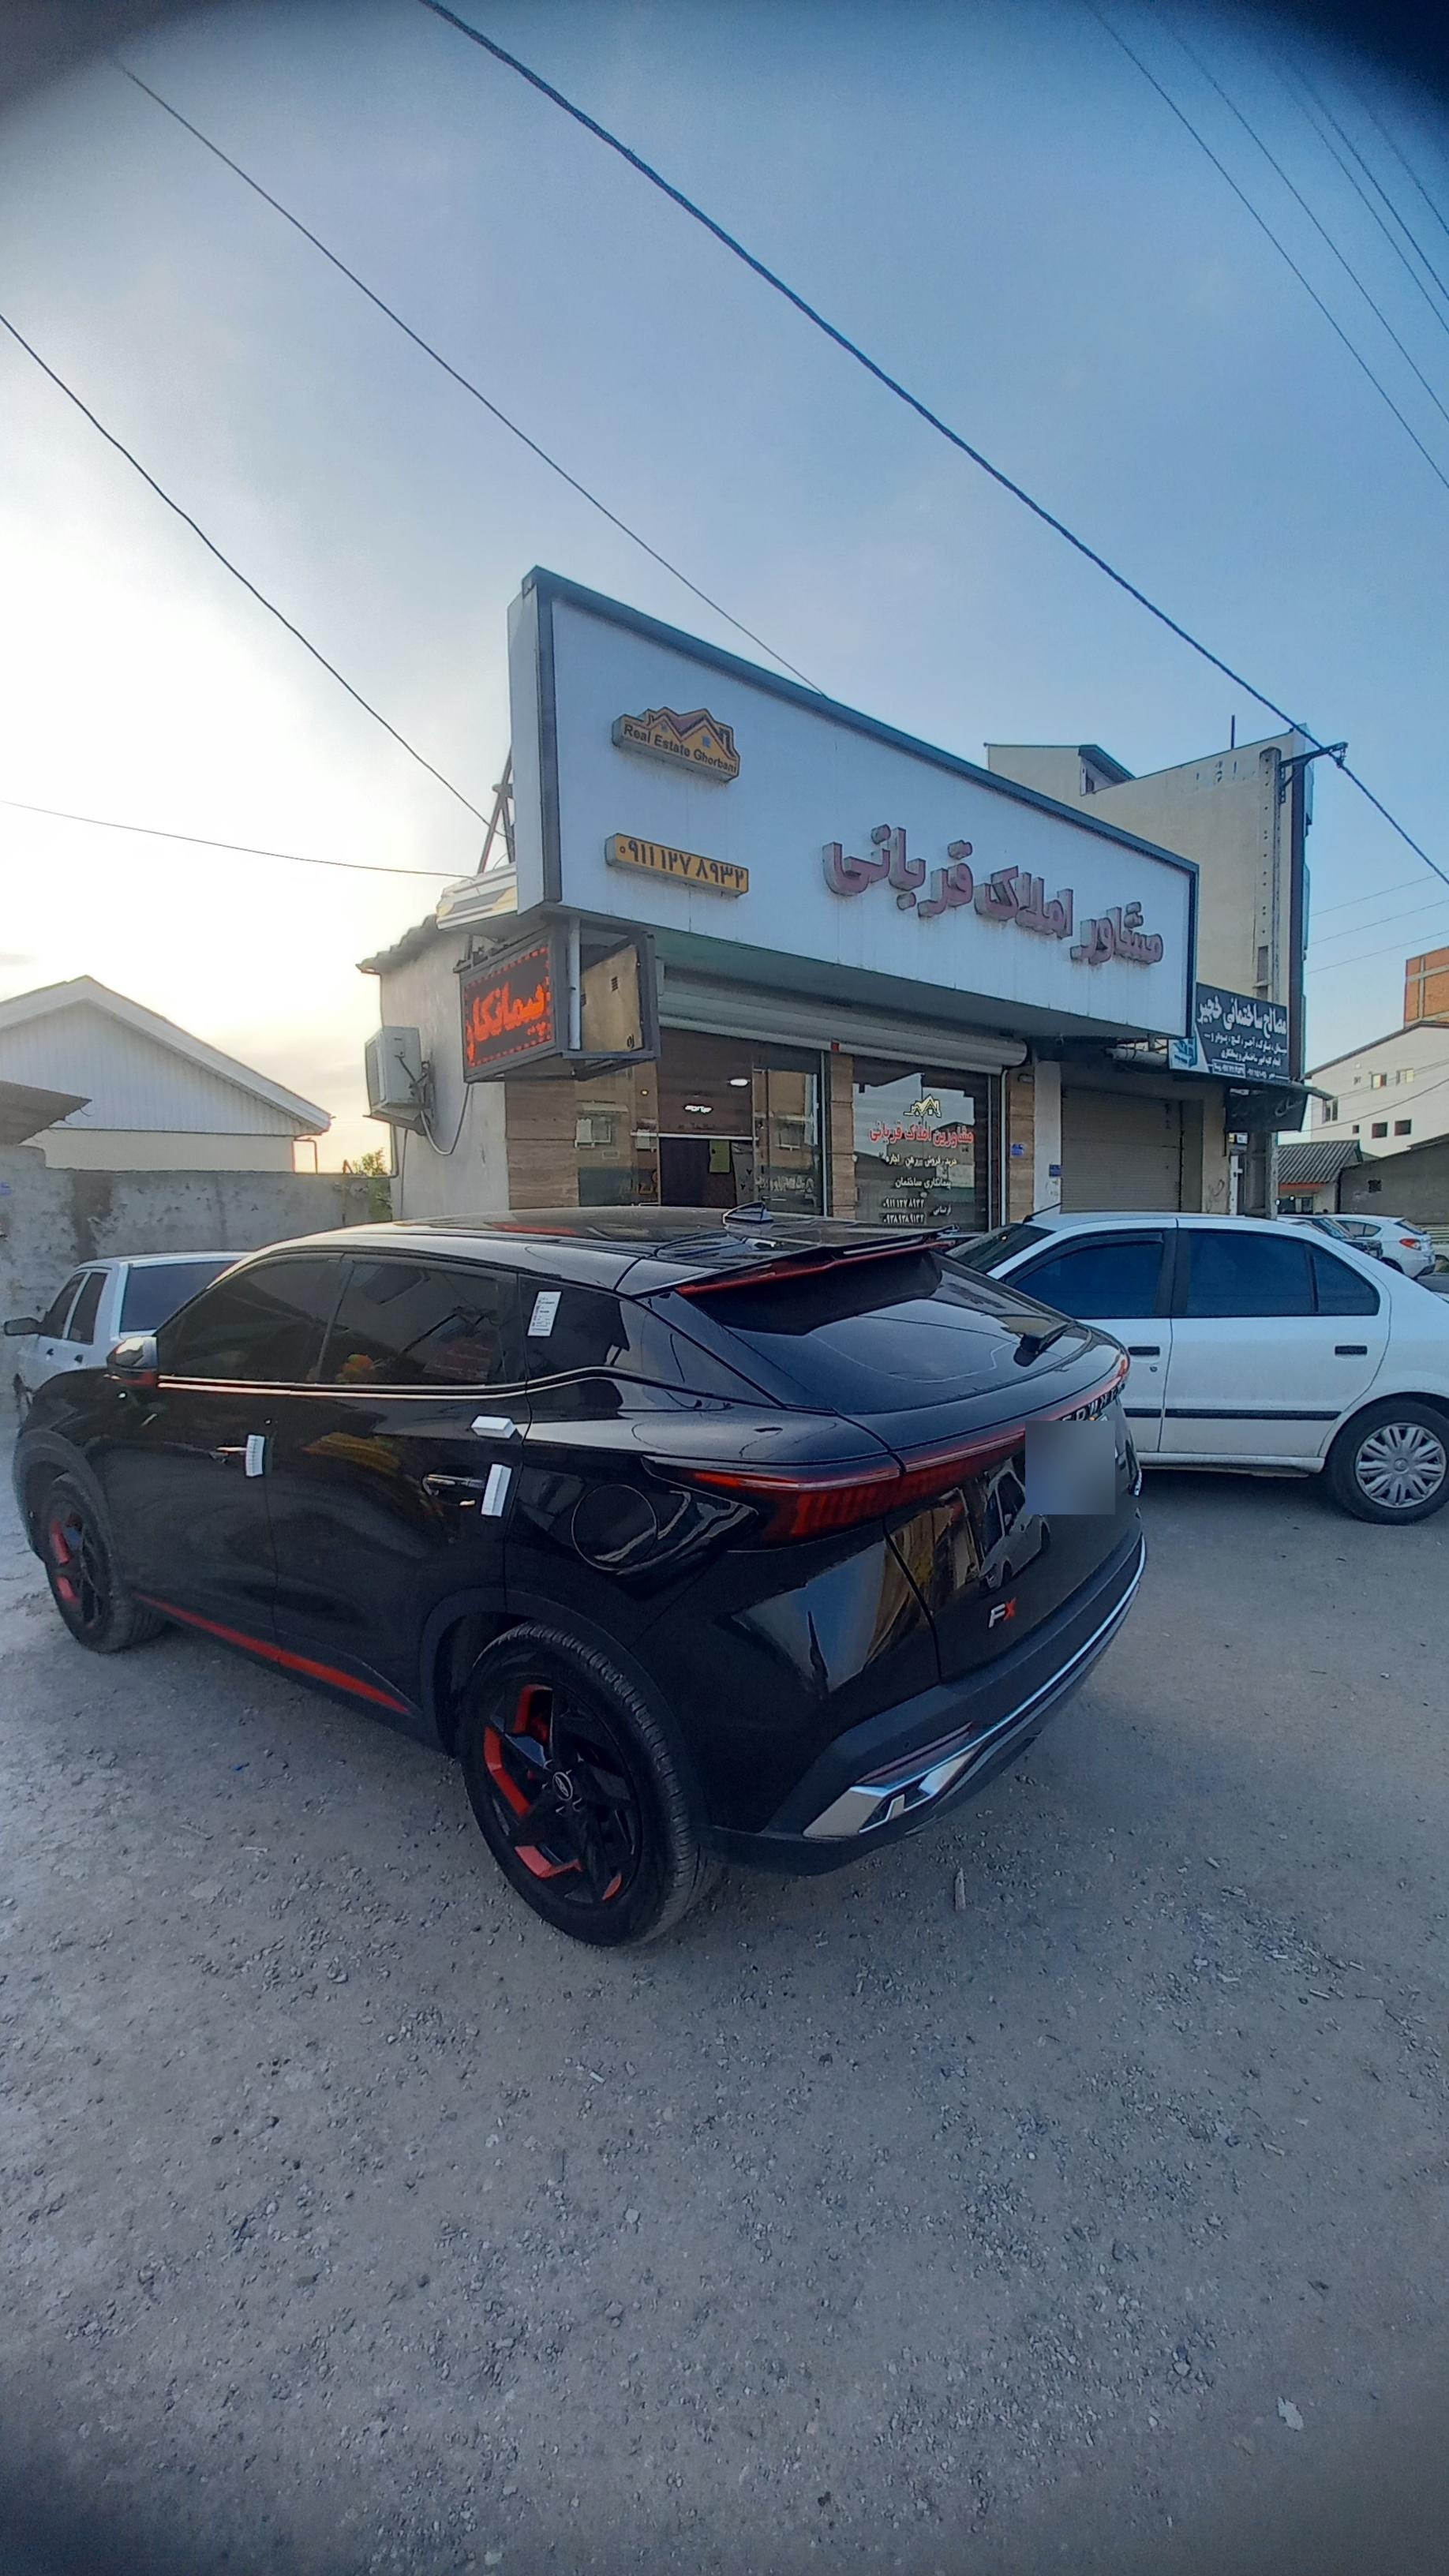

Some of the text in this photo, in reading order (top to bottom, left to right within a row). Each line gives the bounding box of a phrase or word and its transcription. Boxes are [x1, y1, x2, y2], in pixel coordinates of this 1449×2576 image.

[623, 723, 737, 773] Real Estate Ghorbani
[822, 824, 1164, 965] مشاور املاک قربانی
[1223, 997, 1263, 1030] ساختمانی
[1262, 1006, 1287, 1039] مصالح
[870, 1120, 974, 1148] مشاورین املاک قربانی
[895, 1177, 952, 1190] پیمانکاری ساختمان
[988, 1597, 1017, 1628] FX
